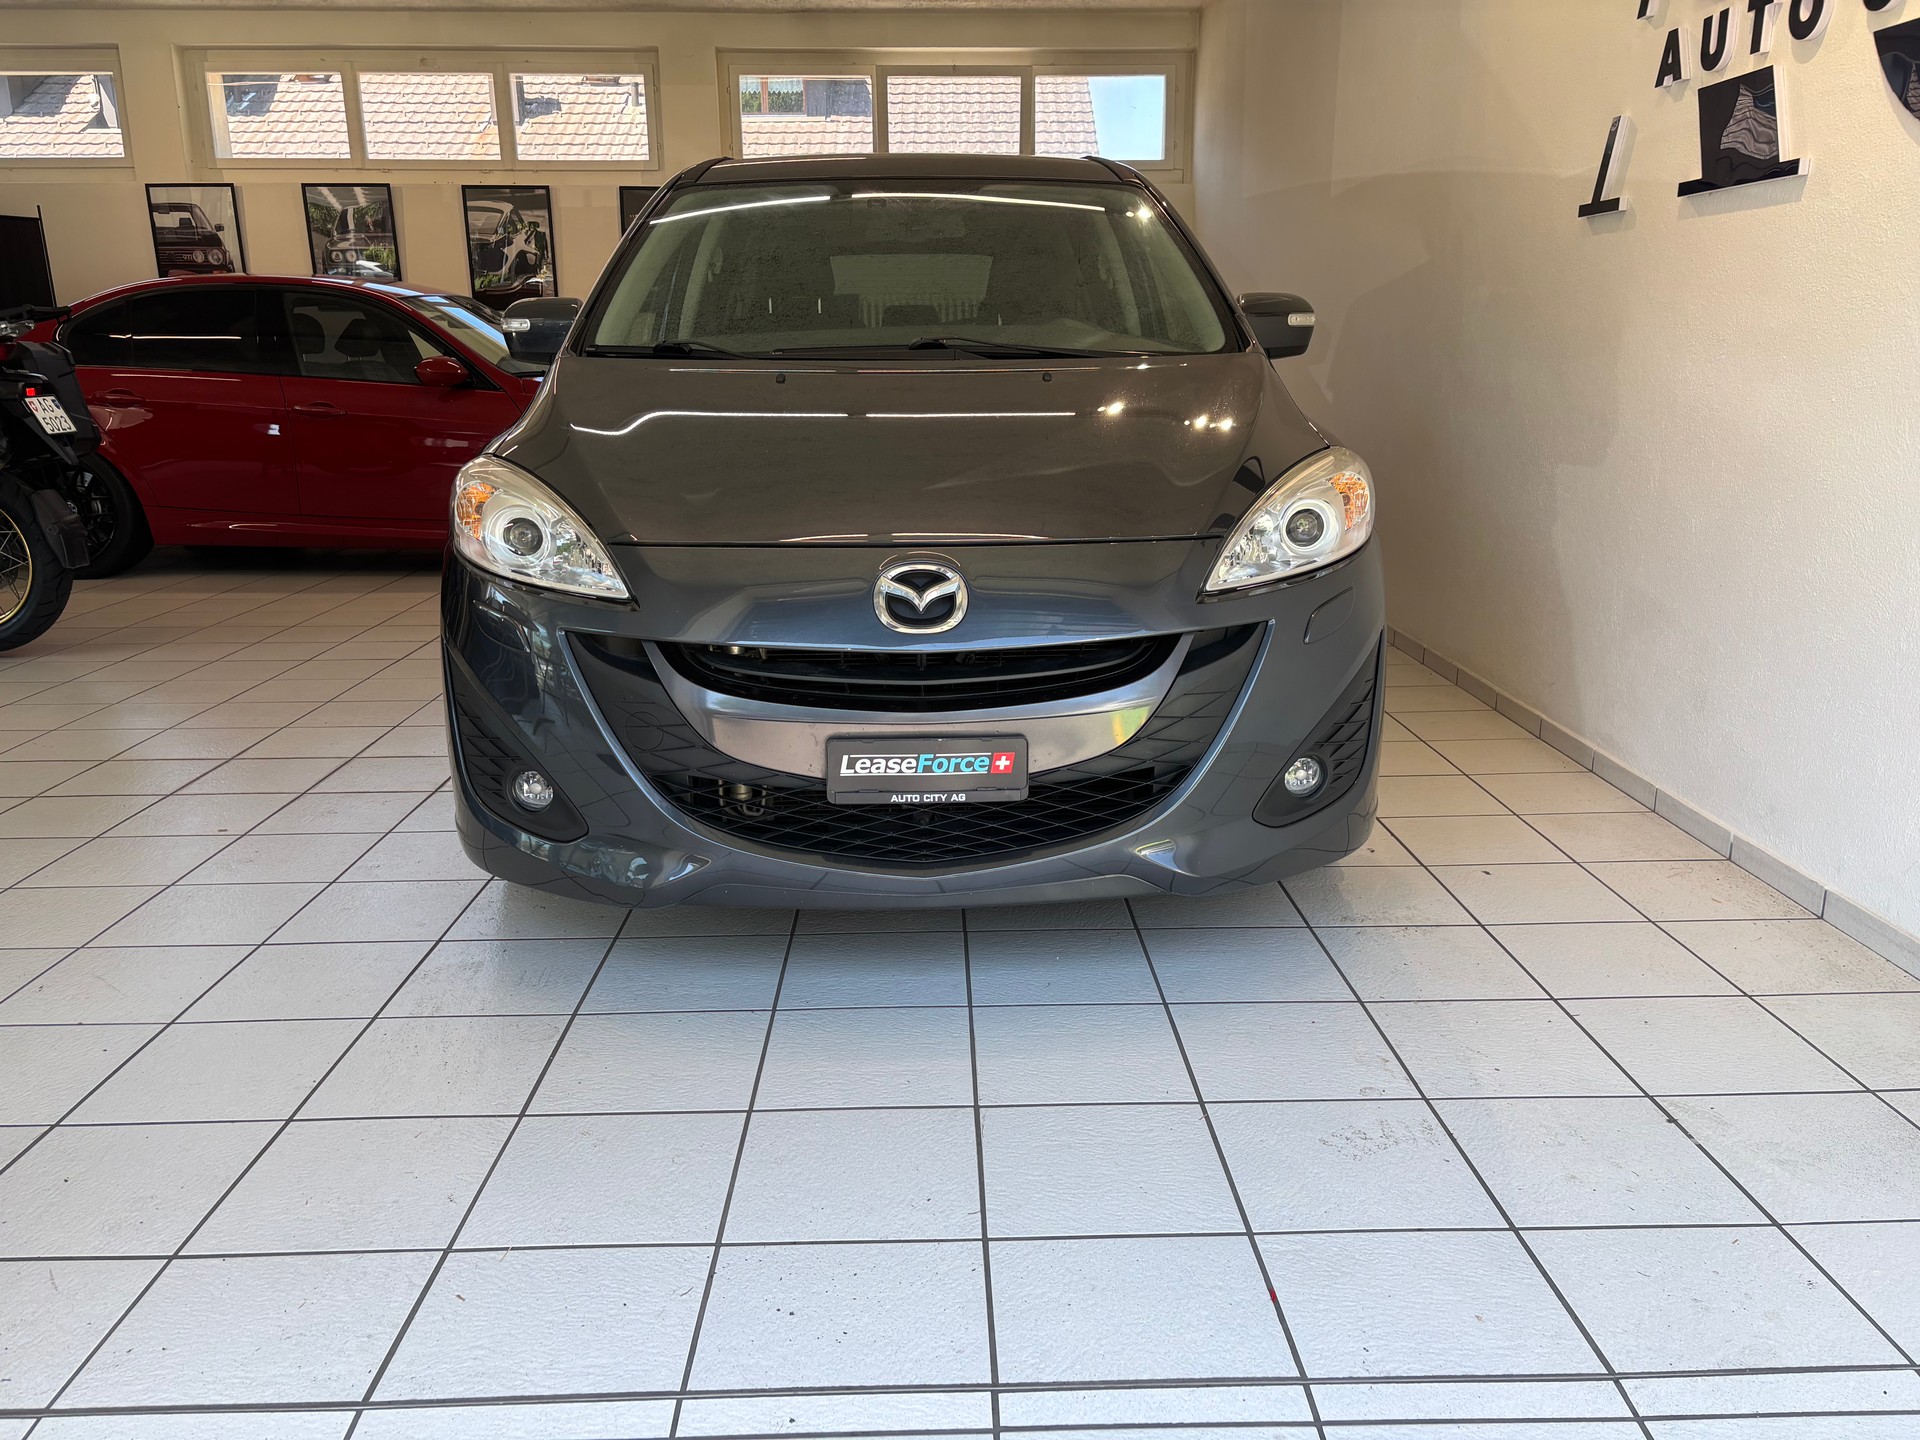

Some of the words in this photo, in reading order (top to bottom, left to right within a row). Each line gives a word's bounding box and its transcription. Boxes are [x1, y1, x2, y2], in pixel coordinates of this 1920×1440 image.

[1654, 0, 1826, 88] AUTO
[37, 398, 55, 414] AG
[42, 415, 72, 432] 5023
[840, 753, 990, 775] LeaseForce
[890, 794, 920, 803] AUTO
[923, 793, 948, 802] CITY
[950, 793, 966, 801] AG
